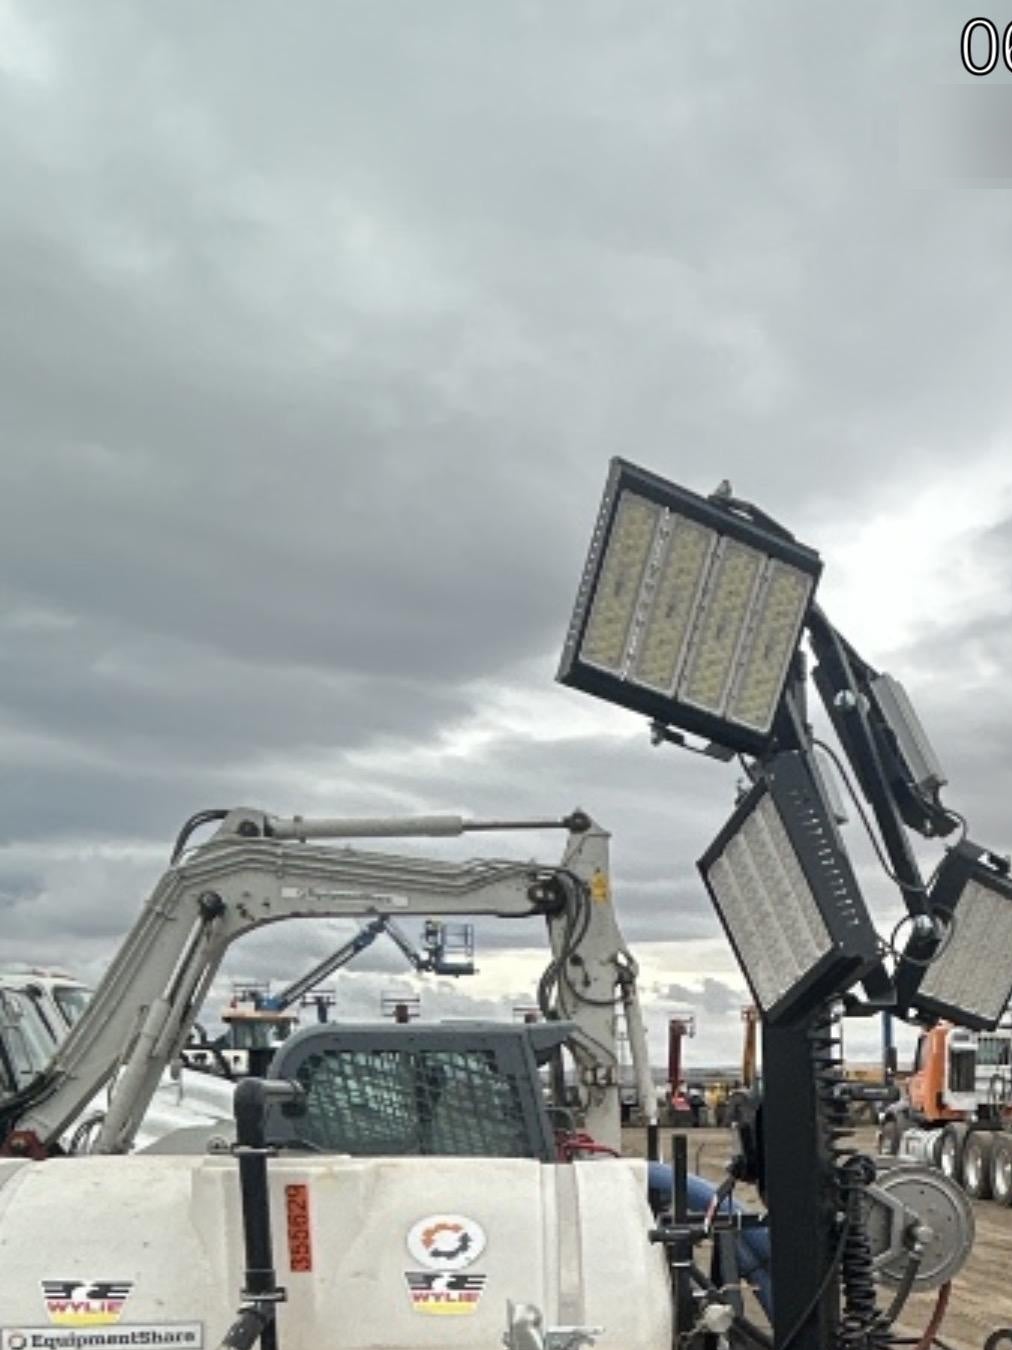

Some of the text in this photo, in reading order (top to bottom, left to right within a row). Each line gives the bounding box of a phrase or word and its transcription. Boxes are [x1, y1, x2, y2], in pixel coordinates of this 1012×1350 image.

[411, 1292, 480, 1302] WYLIE
[47, 1301, 124, 1314] WYLIE
[31, 1330, 196, 1350] EquipmentShare
